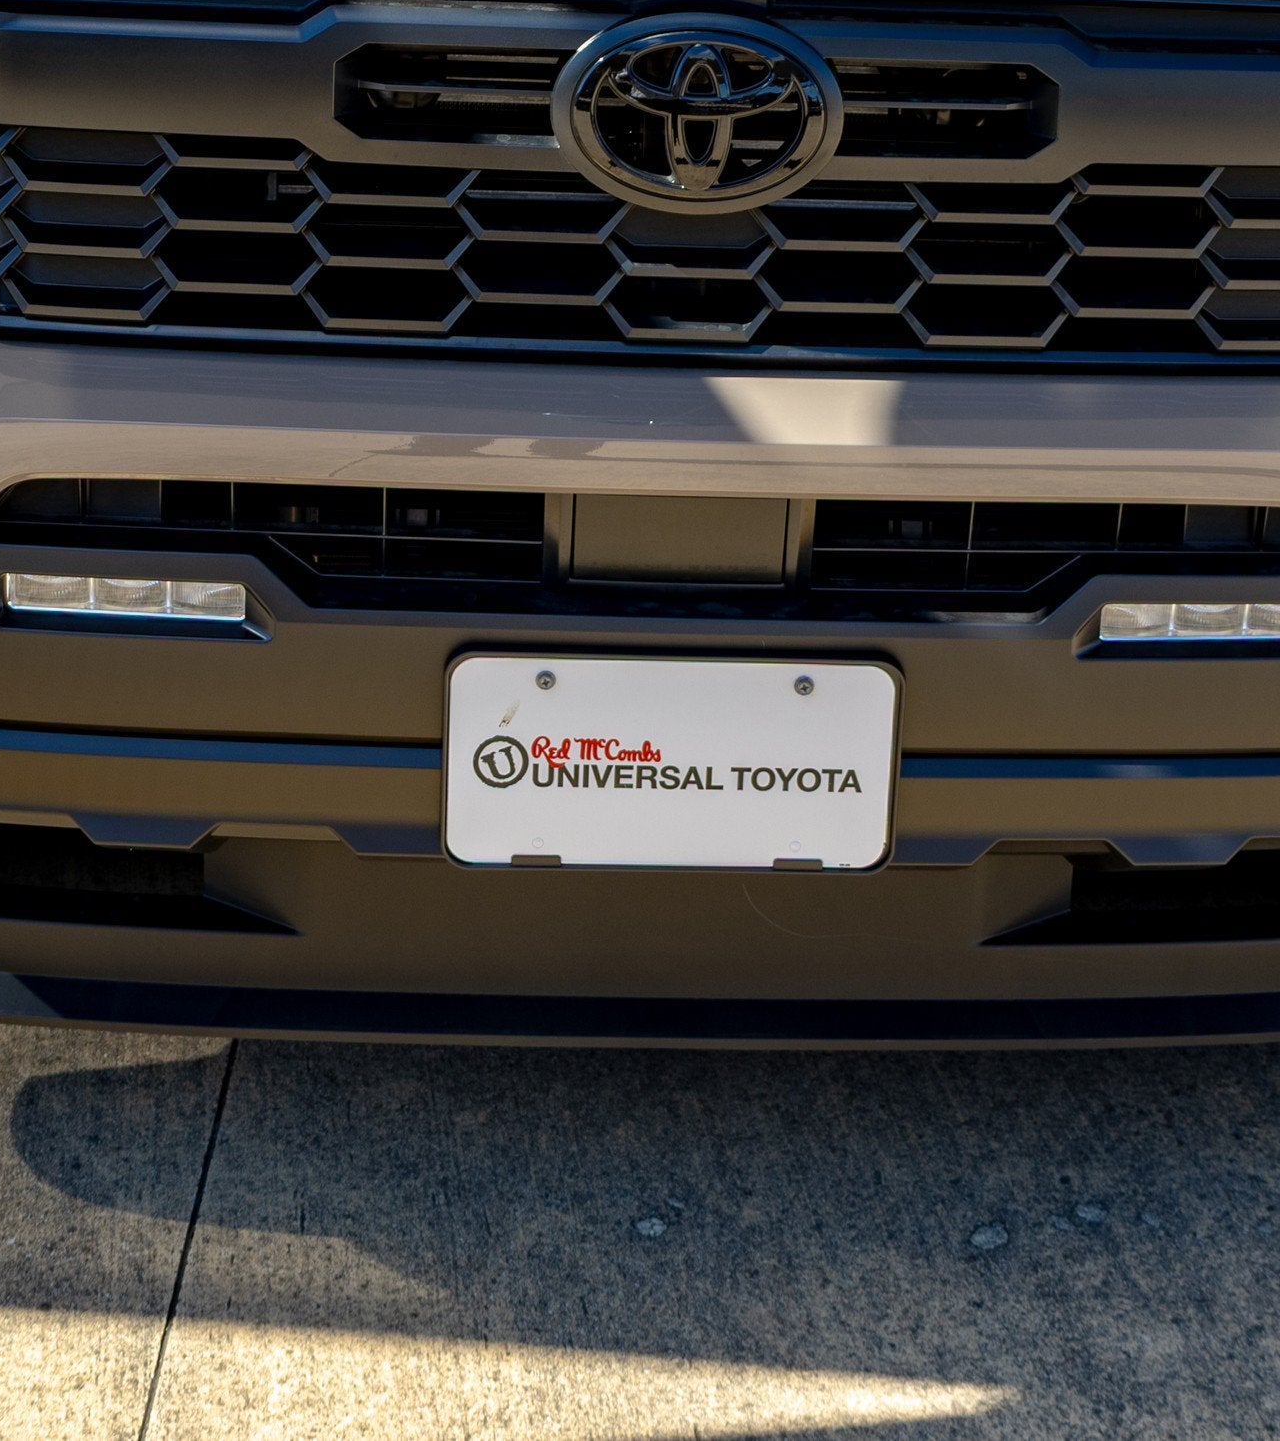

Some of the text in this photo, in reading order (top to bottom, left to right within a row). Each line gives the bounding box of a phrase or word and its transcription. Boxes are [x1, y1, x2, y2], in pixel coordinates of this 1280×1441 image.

[531, 736, 661, 768] Red McCombs
[532, 764, 862, 793] UNIVERSAL TOYOTA
